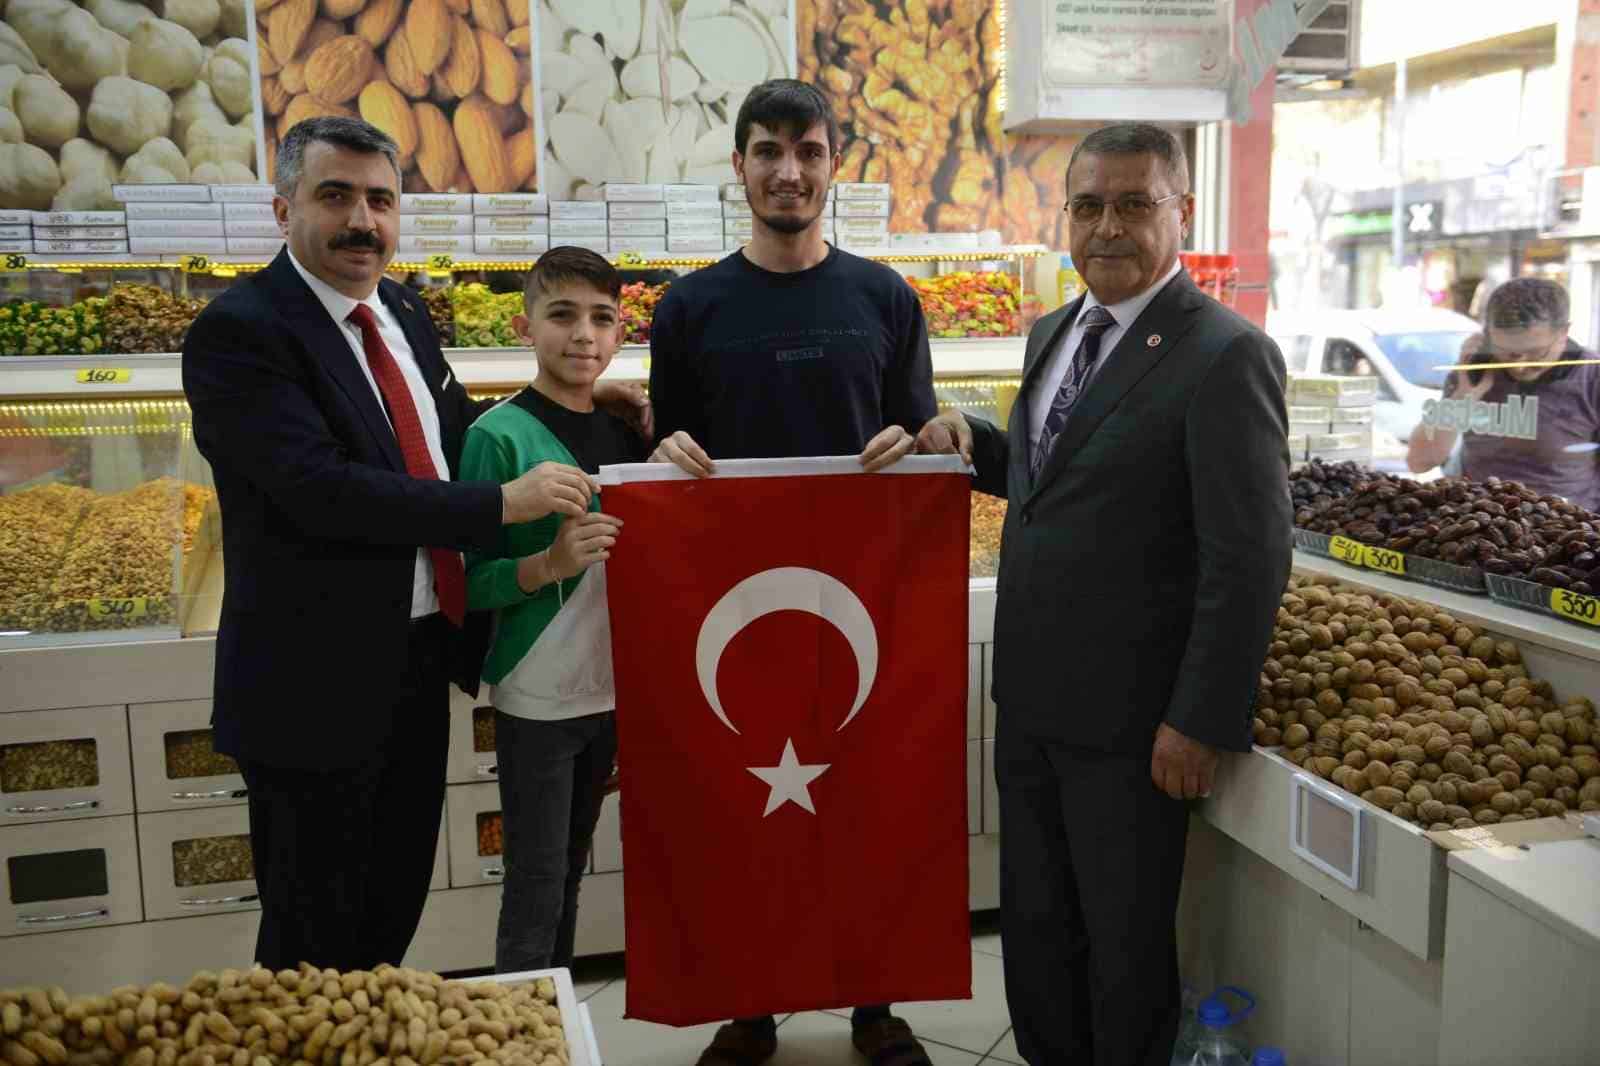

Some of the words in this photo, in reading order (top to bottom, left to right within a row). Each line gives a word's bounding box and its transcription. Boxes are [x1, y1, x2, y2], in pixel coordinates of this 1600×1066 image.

[6, 254, 26, 269] 80
[188, 255, 207, 270] 70
[87, 369, 117, 382] 160
[1370, 547, 1399, 570] 300
[100, 600, 135, 616] 340
[1560, 591, 1597, 619] 350
